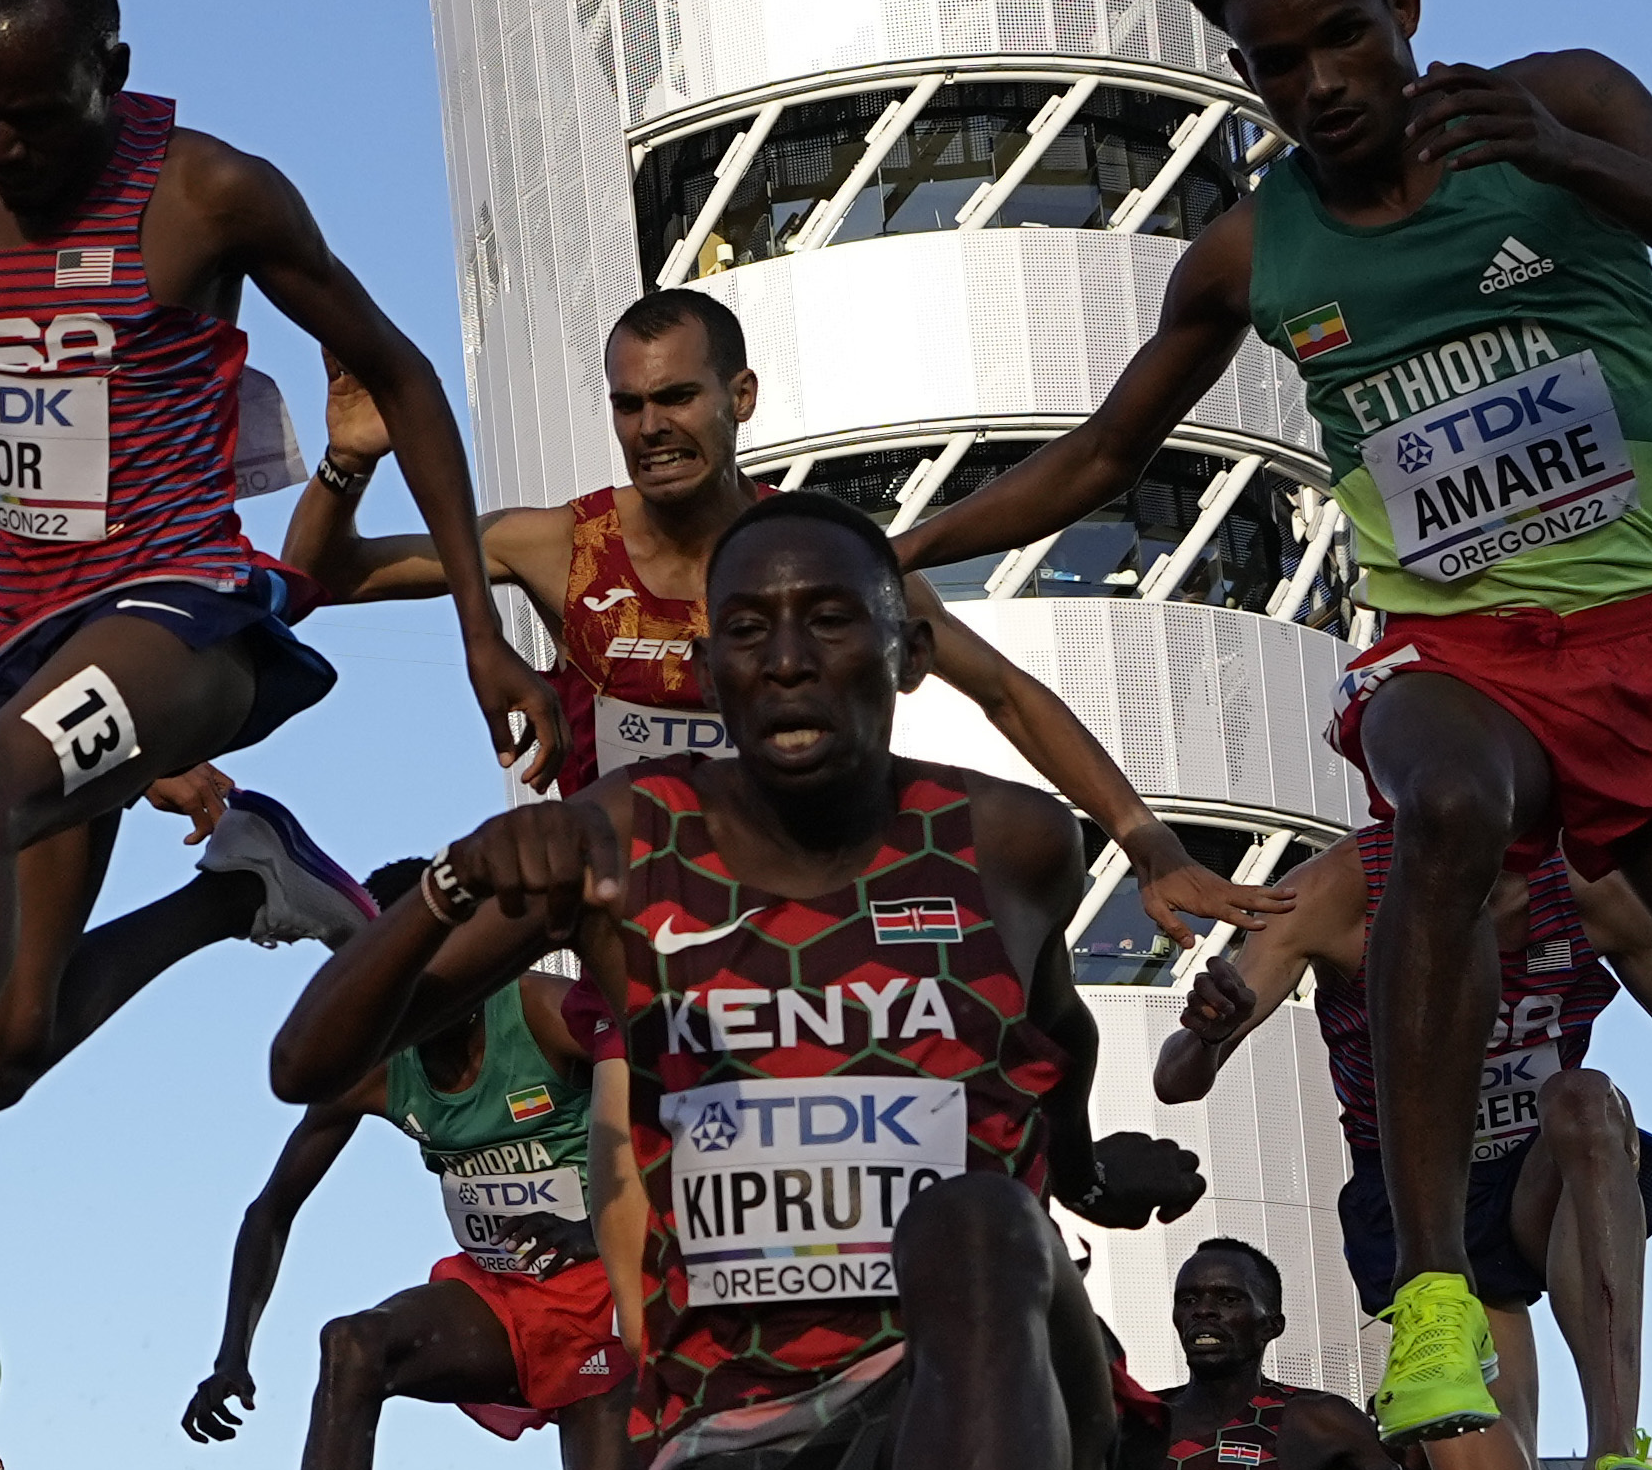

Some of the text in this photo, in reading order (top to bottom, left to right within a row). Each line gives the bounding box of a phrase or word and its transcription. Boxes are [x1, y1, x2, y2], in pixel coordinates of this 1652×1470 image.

[1478, 254, 1555, 296] adidas
[1342, 317, 1560, 433] ETHIOPIA
[1424, 373, 1576, 455] TDK
[1413, 423, 1606, 541] AMARE
[1438, 499, 1608, 577] OREGON22
[604, 636, 694, 661] ESP
[55, 686, 121, 773] 13
[650, 716, 735, 749] TD
[661, 977, 957, 1056] KENYA
[1480, 1053, 1538, 1091] DK
[735, 1094, 921, 1148] TDK
[475, 1178, 559, 1206] TDK
[713, 1261, 893, 1299] OREGON2
